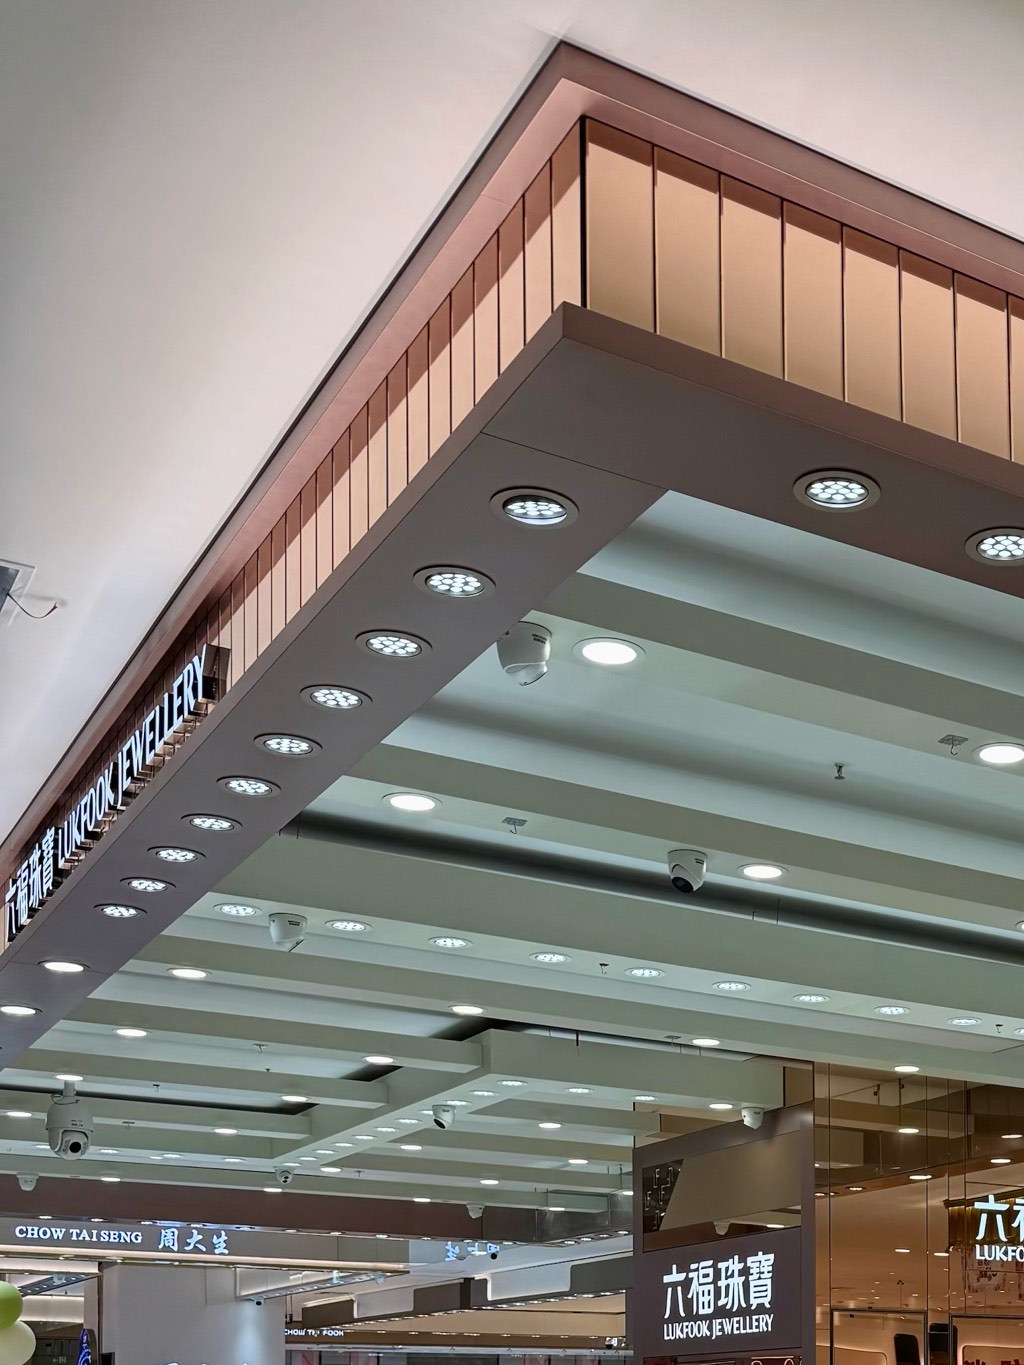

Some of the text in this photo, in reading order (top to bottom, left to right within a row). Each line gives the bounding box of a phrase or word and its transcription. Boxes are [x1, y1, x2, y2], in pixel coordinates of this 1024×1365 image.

[5, 643, 207, 940] 六福珠寶 LUKFOOK JEWELLERY
[15, 1225, 230, 1255] CHOW TAI SENG 周大生
[663, 1251, 775, 1319] 六福珠寶
[663, 1313, 774, 1340] LUKFOOK JEWELLERY
